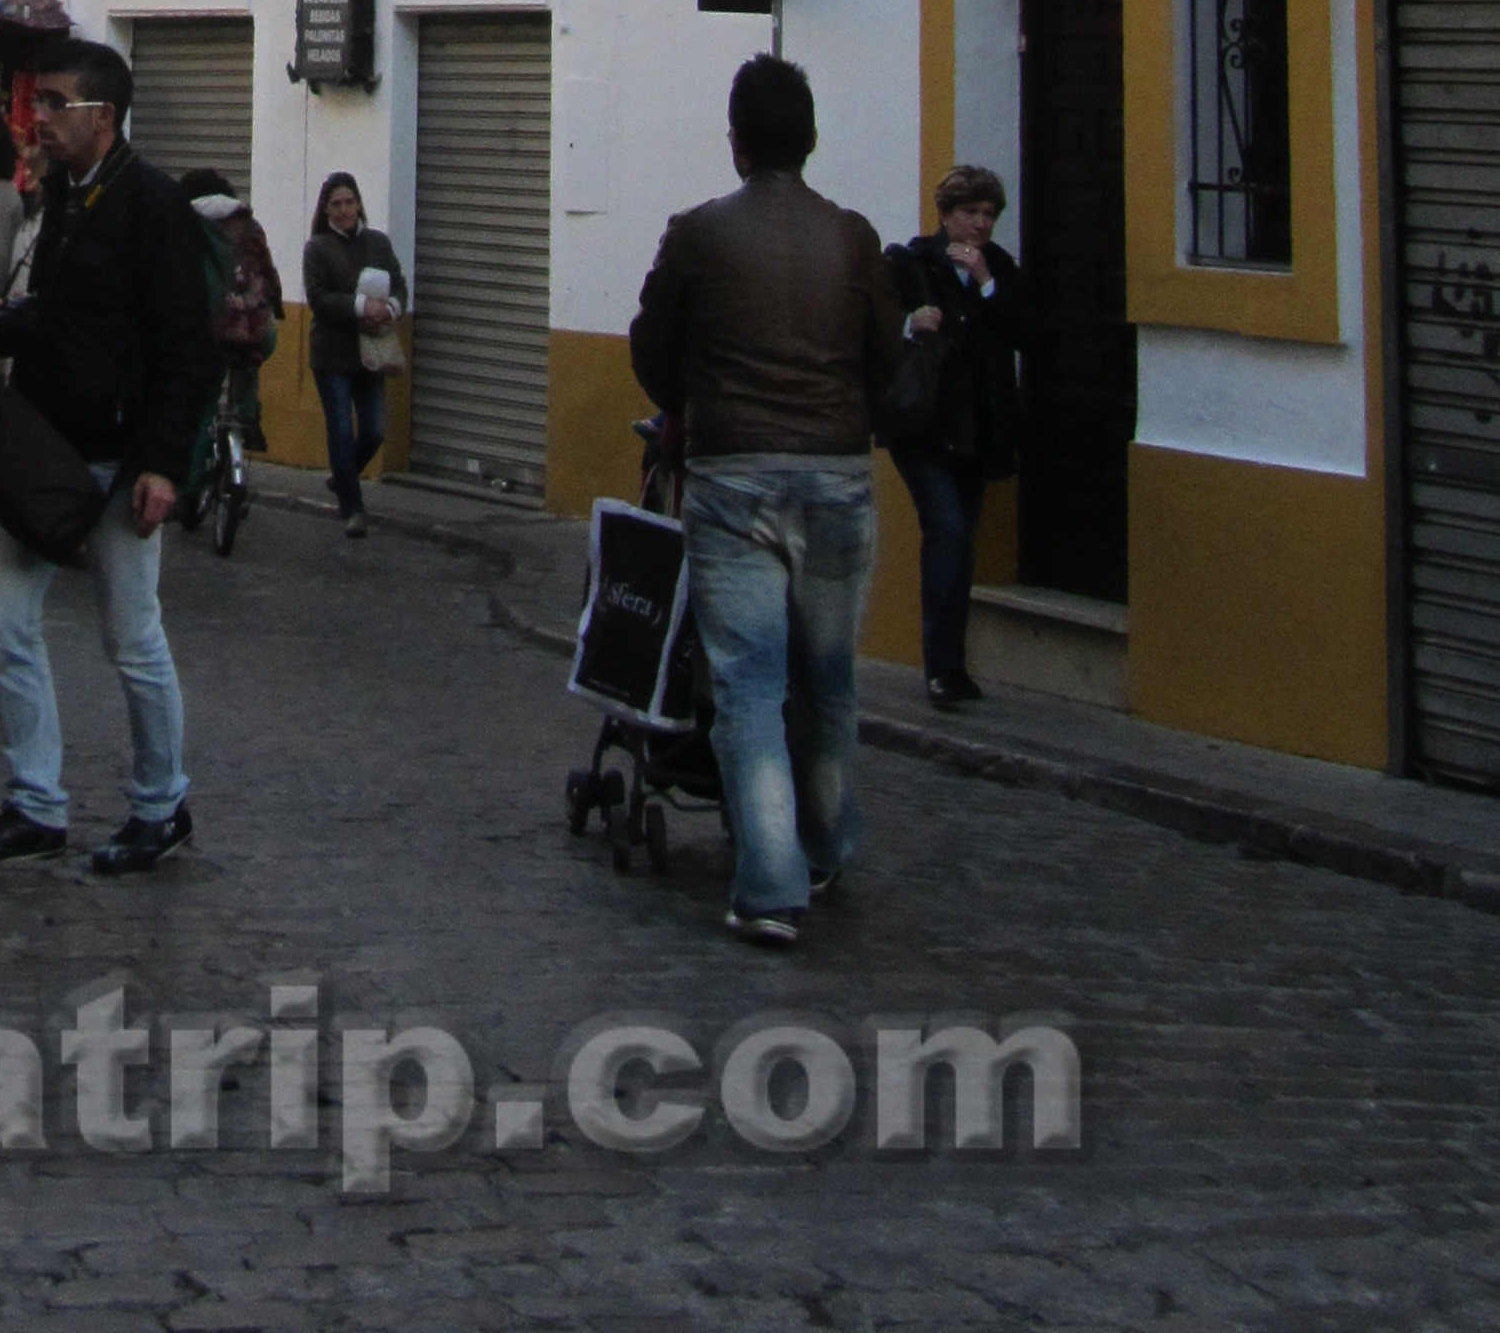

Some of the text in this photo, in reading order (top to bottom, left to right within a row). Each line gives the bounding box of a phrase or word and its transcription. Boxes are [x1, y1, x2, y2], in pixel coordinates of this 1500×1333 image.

[309, 9, 342, 23] BEBIDAS
[303, 28, 345, 43] PALOMITAS
[307, 48, 342, 63] HELADOS
